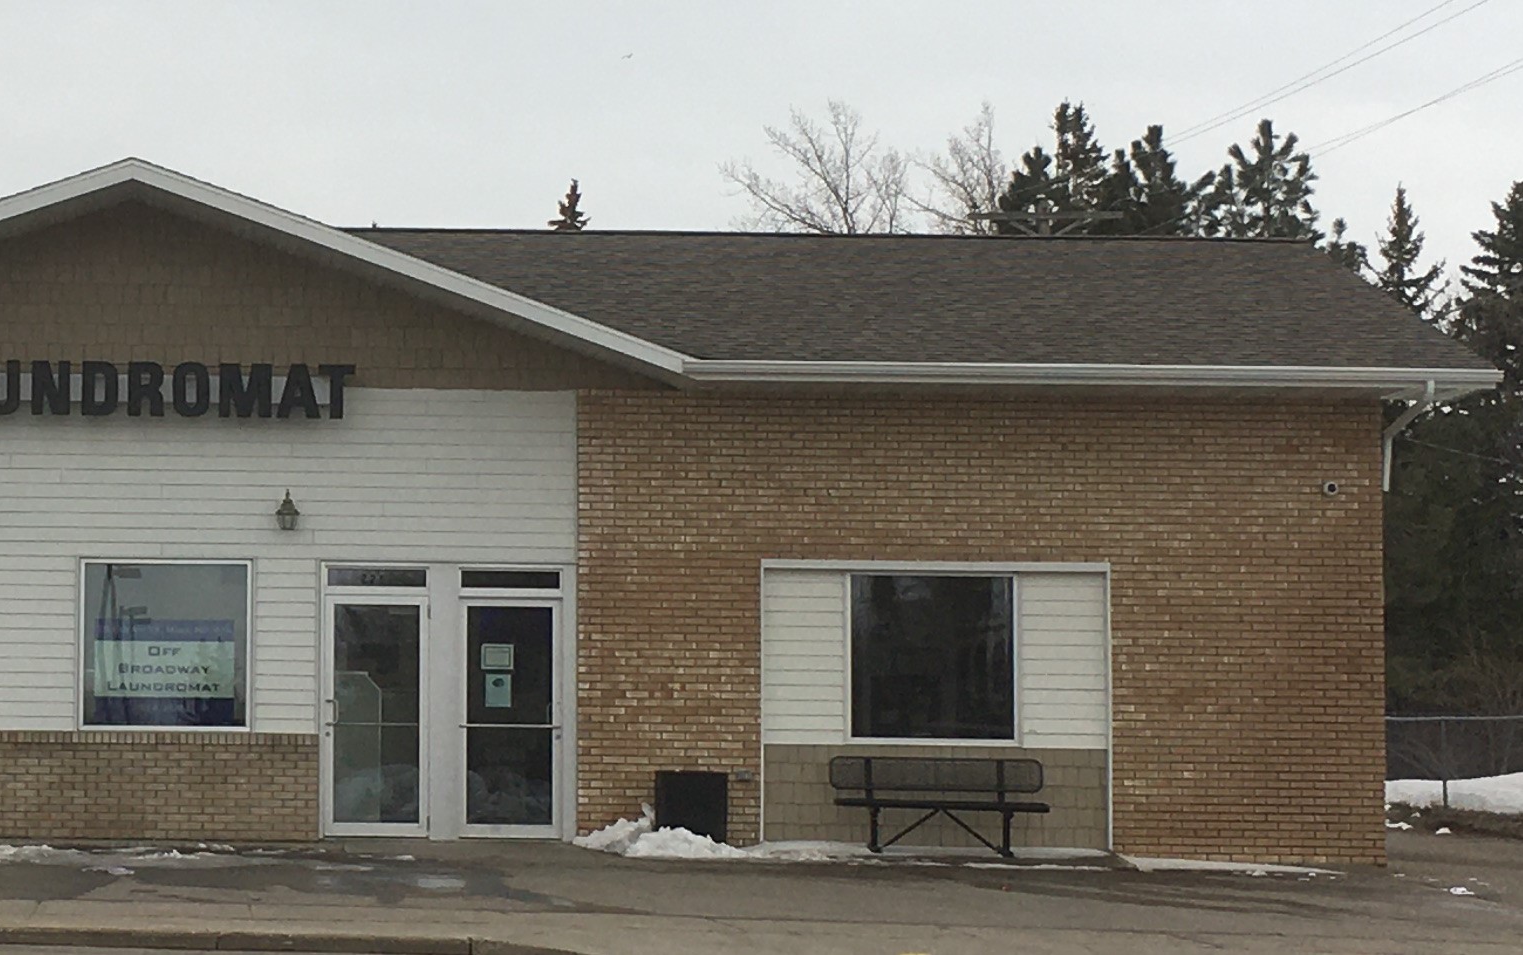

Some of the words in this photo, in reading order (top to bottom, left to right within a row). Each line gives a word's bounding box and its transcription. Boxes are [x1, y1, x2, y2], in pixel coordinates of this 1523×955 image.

[148, 646, 181, 656] OFF
[118, 662, 210, 674] BROADWAY
[107, 680, 221, 692] LAUNDROMAT
